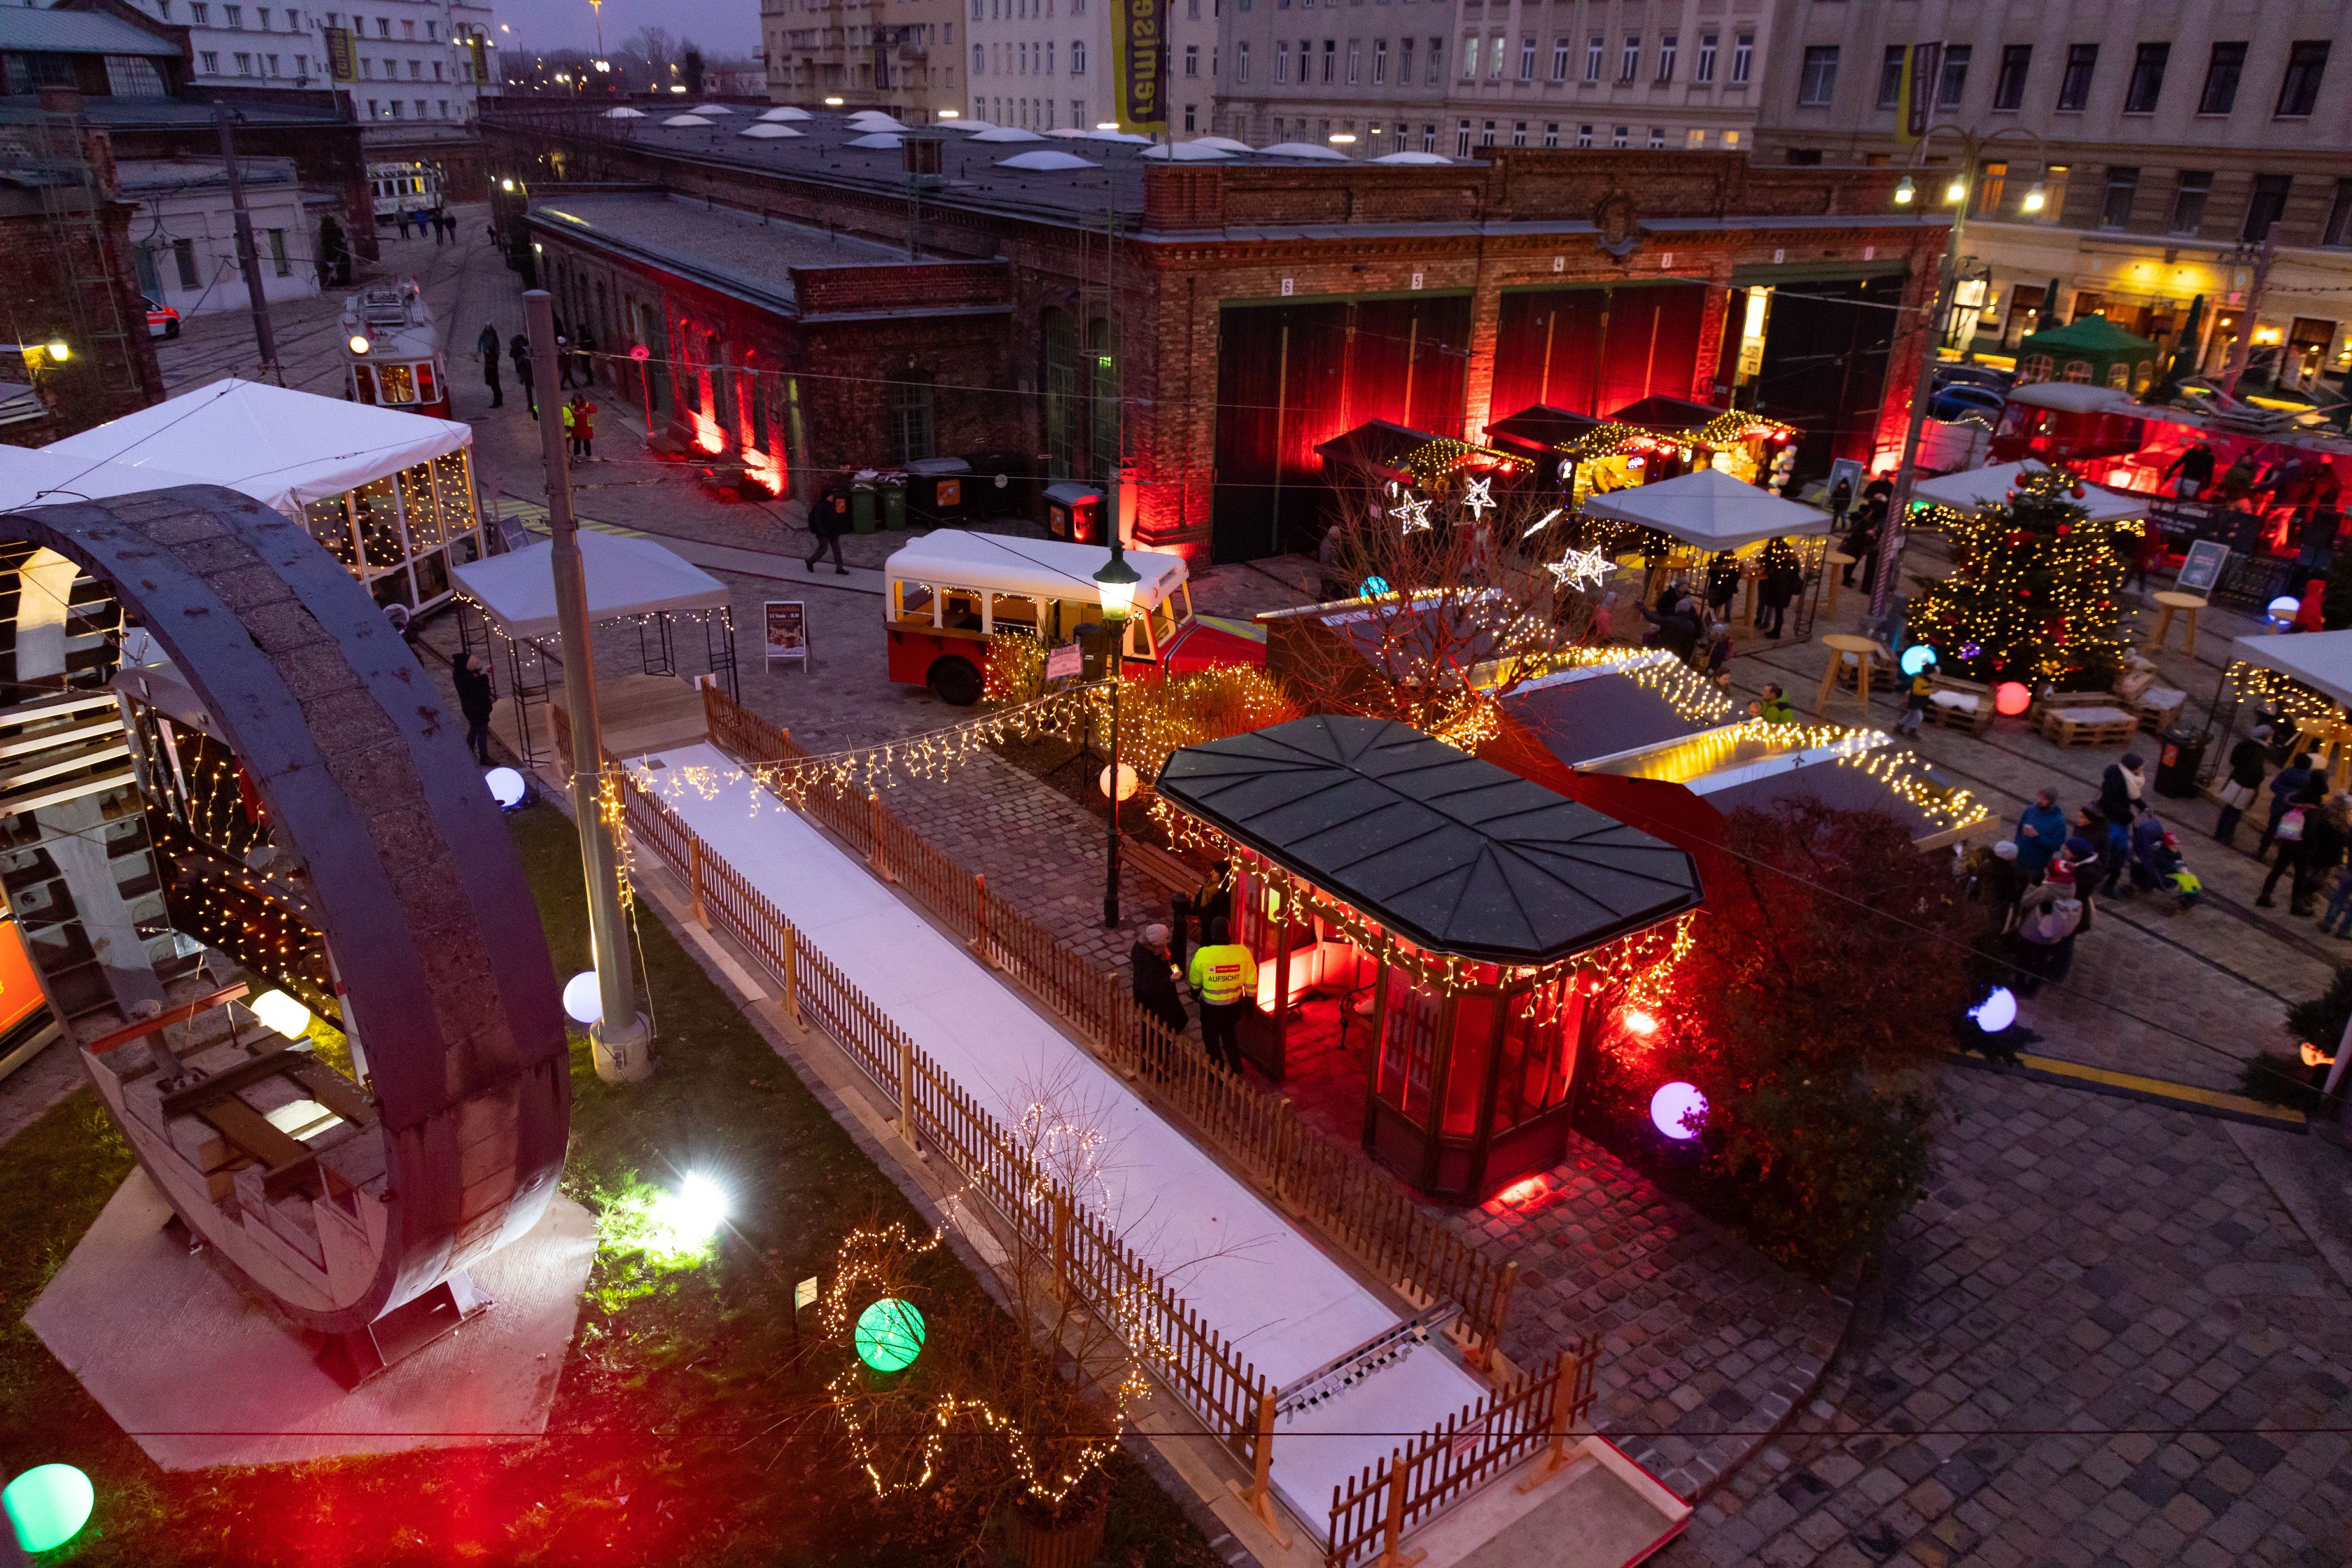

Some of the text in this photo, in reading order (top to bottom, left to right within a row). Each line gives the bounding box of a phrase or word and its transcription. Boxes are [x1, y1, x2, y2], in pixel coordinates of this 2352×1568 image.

[1284, 281, 1290, 293] 6
[1414, 276, 1420, 288] 5
[1562, 461, 1572, 479] 2
